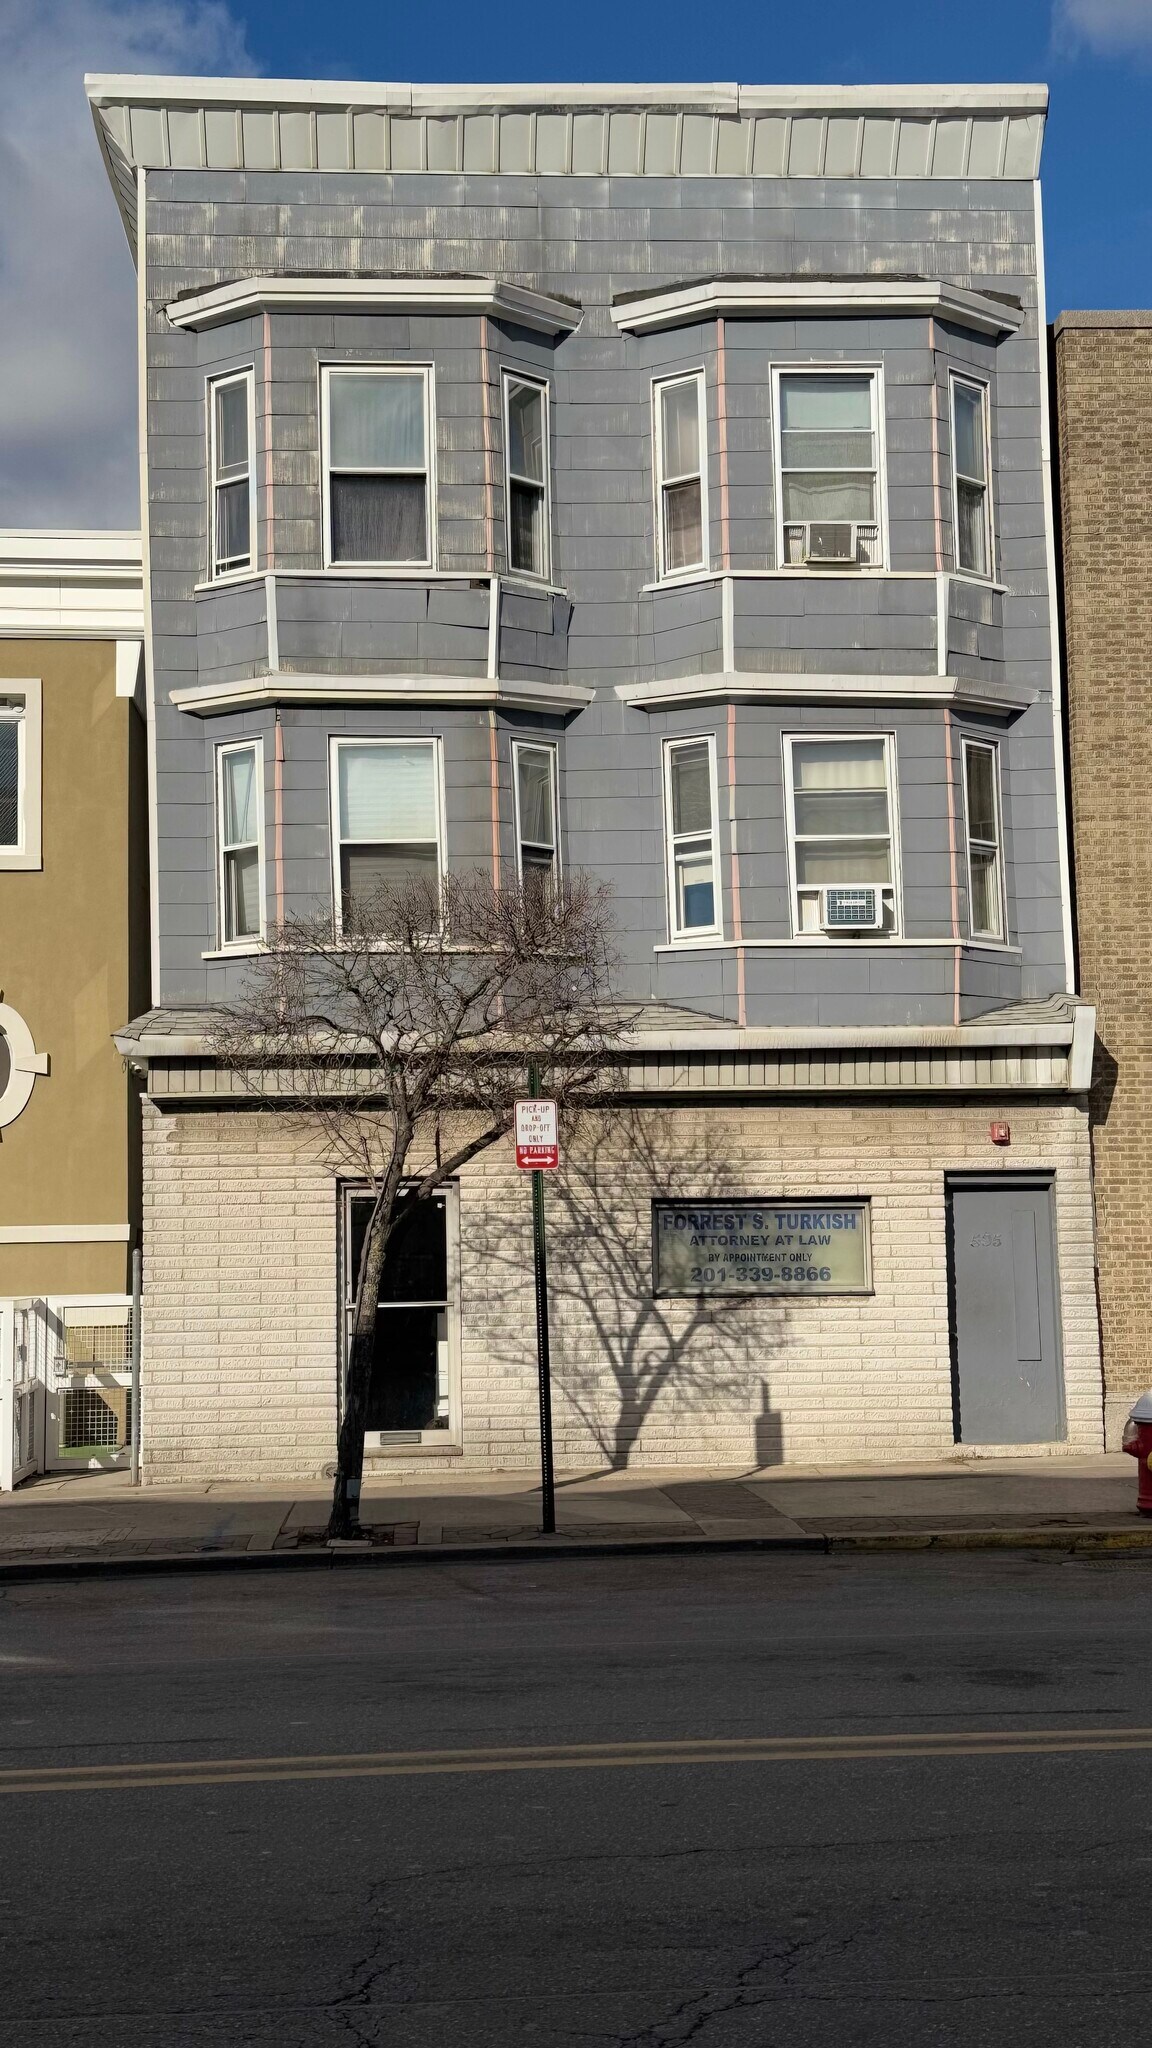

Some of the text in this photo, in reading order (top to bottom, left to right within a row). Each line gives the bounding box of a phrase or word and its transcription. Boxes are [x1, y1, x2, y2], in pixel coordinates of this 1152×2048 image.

[521, 1105, 550, 1114] PICK-UP
[520, 1124, 550, 1132] DROP-OFF
[528, 1135, 544, 1143] ONLY
[519, 1146, 555, 1155] NO PARKING
[663, 1213, 856, 1230] FORREST S. TURKISH
[689, 1235, 831, 1246] ATTORNEY AT LAW
[708, 1253, 813, 1262] BY APPOINTMENT ONLY
[690, 1267, 832, 1282] 201-339-8866
